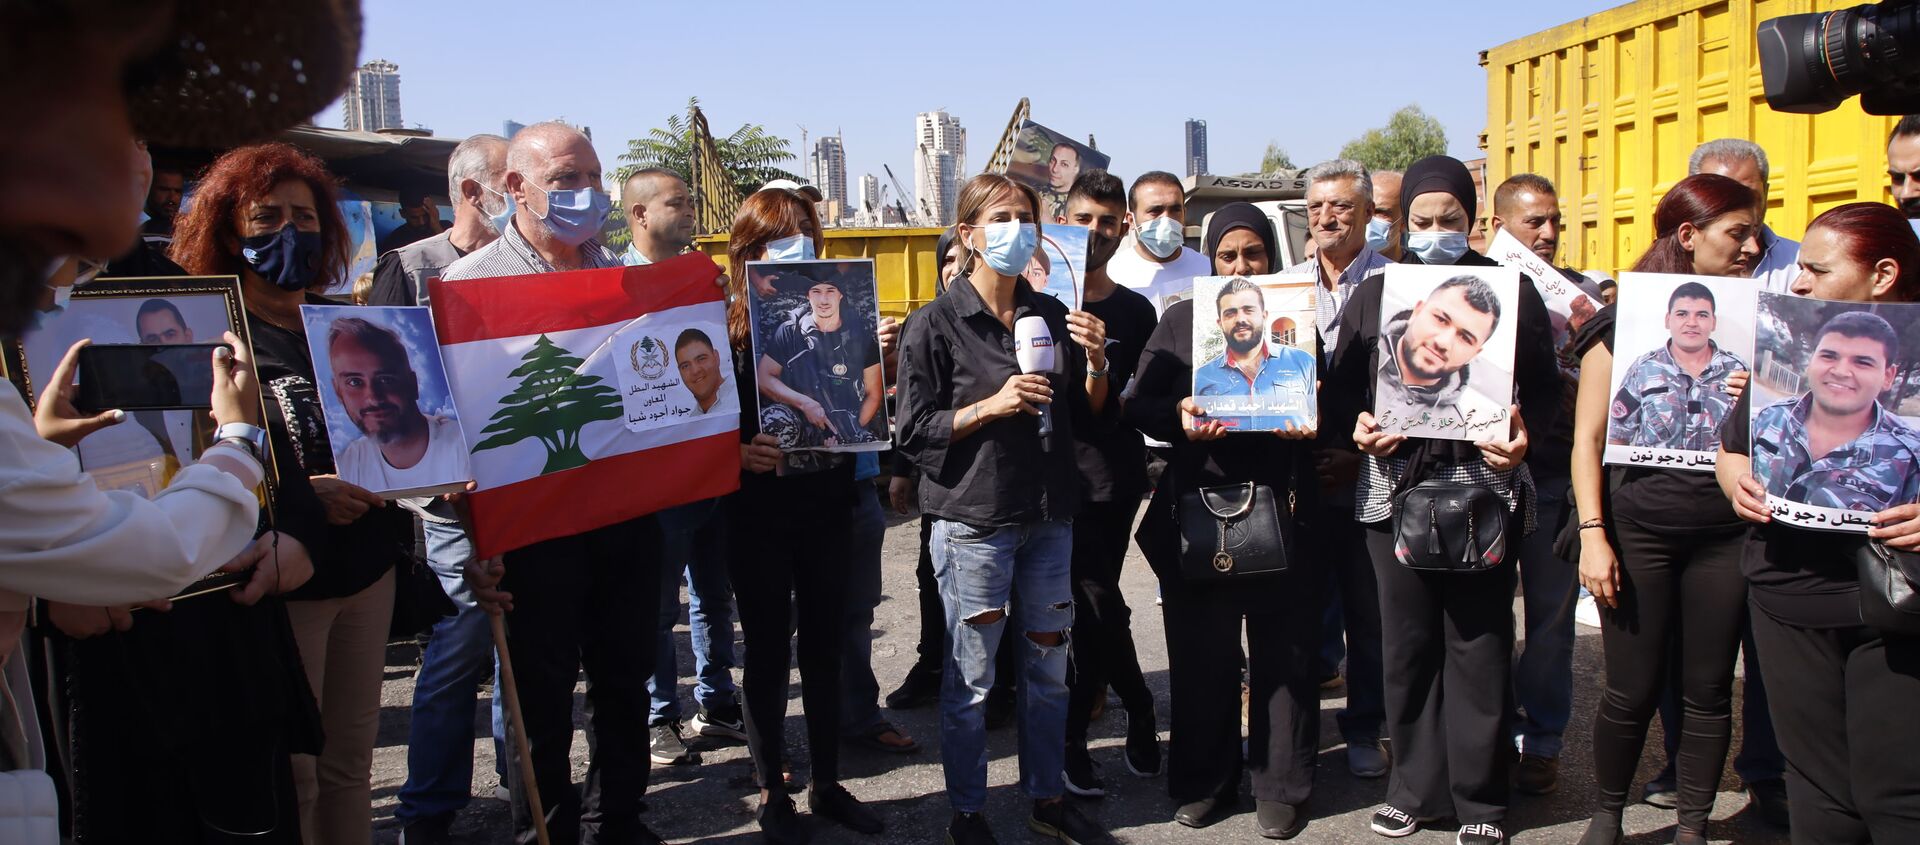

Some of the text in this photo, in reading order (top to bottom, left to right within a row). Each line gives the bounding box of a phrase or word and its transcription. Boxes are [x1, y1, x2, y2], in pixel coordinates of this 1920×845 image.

[1212, 178, 1282, 189] ASSAD
[629, 378, 681, 396] الشهيد البطل
[643, 393, 667, 407] المعاون
[1238, 397, 1265, 411] أحمد
[1267, 398, 1302, 414] الشهيد
[649, 404, 668, 422] أجود
[671, 405, 691, 417] جواد
[1453, 408, 1477, 430] محمد
[1468, 408, 1507, 431] الشهيد
[1630, 450, 1654, 463] نون
